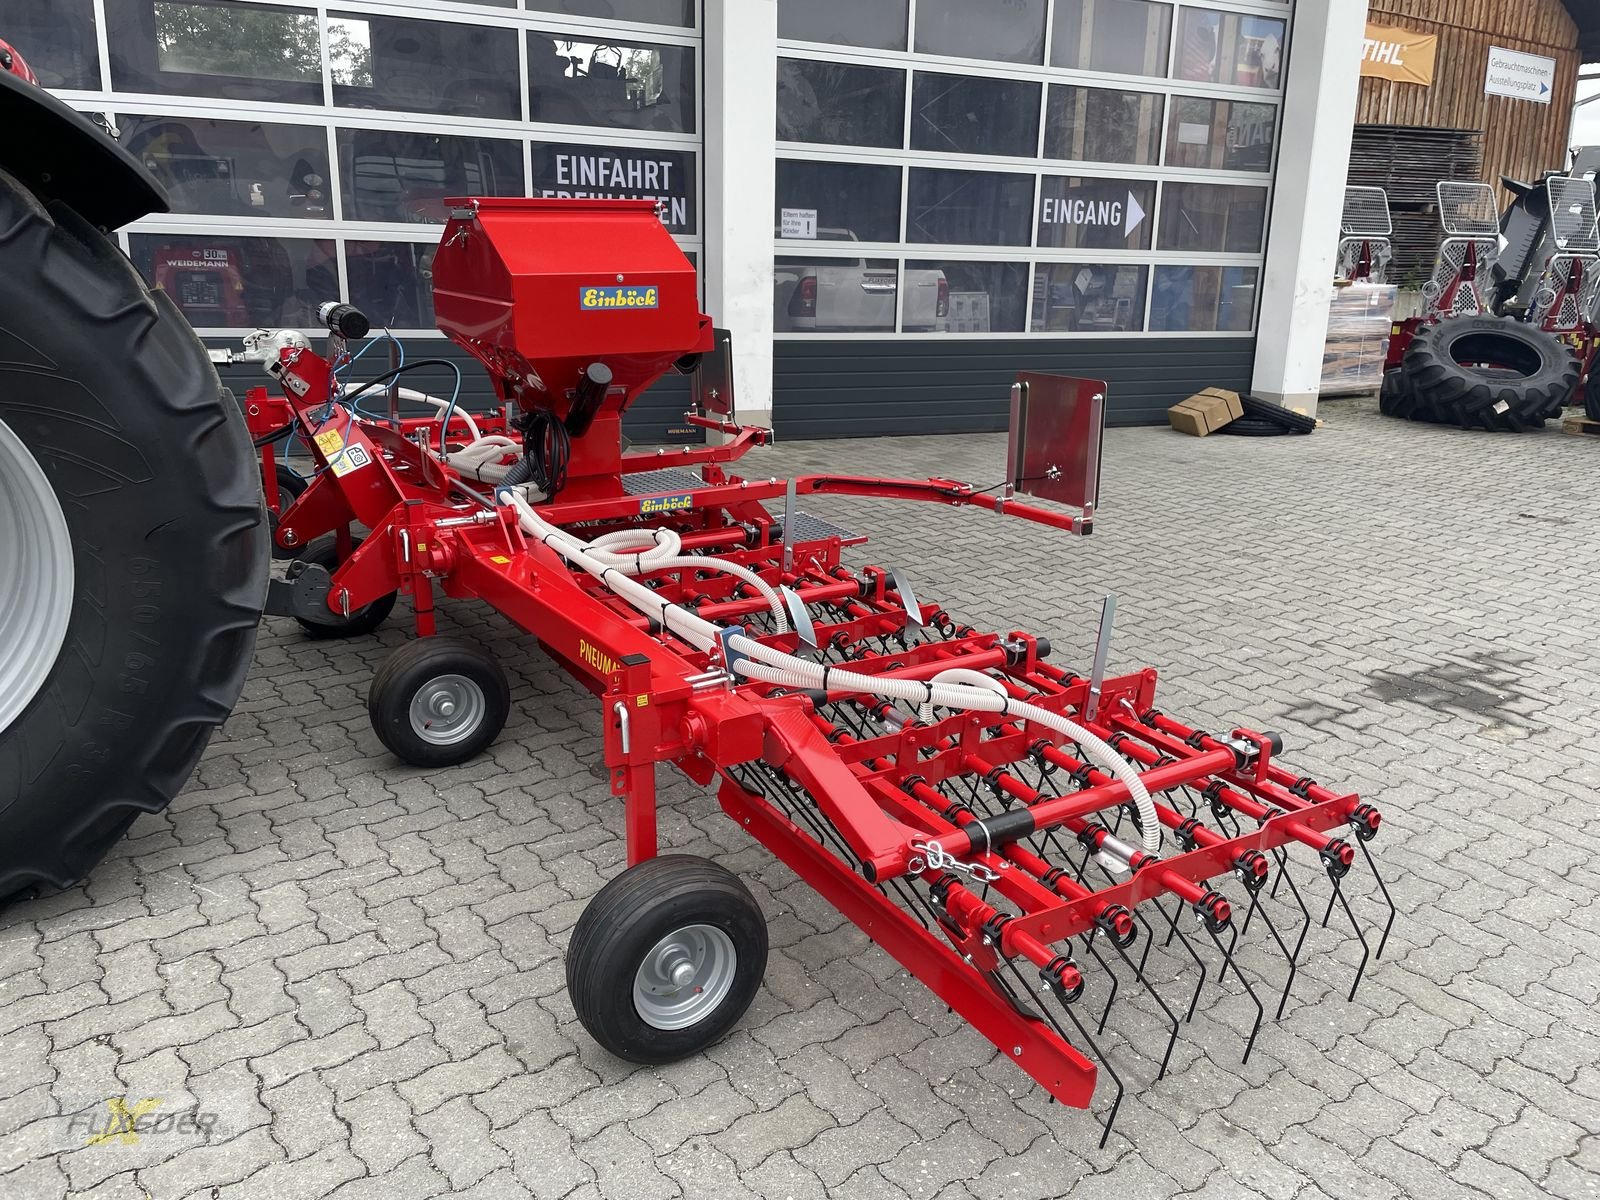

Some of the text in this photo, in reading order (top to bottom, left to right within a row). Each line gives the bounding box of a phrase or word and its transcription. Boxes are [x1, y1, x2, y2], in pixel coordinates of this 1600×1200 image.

[1360, 39, 1404, 66] TIHL
[1490, 57, 1548, 77] Gebrauchtmaschinen
[1489, 74, 1537, 91] Ausstellungsplatz
[556, 154, 673, 191] EINFAHRT
[1042, 198, 1121, 226] EINGANG
[166, 259, 229, 268] WEIDEMANN
[205, 251, 217, 259] 30
[583, 288, 656, 307] Einböck
[641, 495, 691, 512] Einböck
